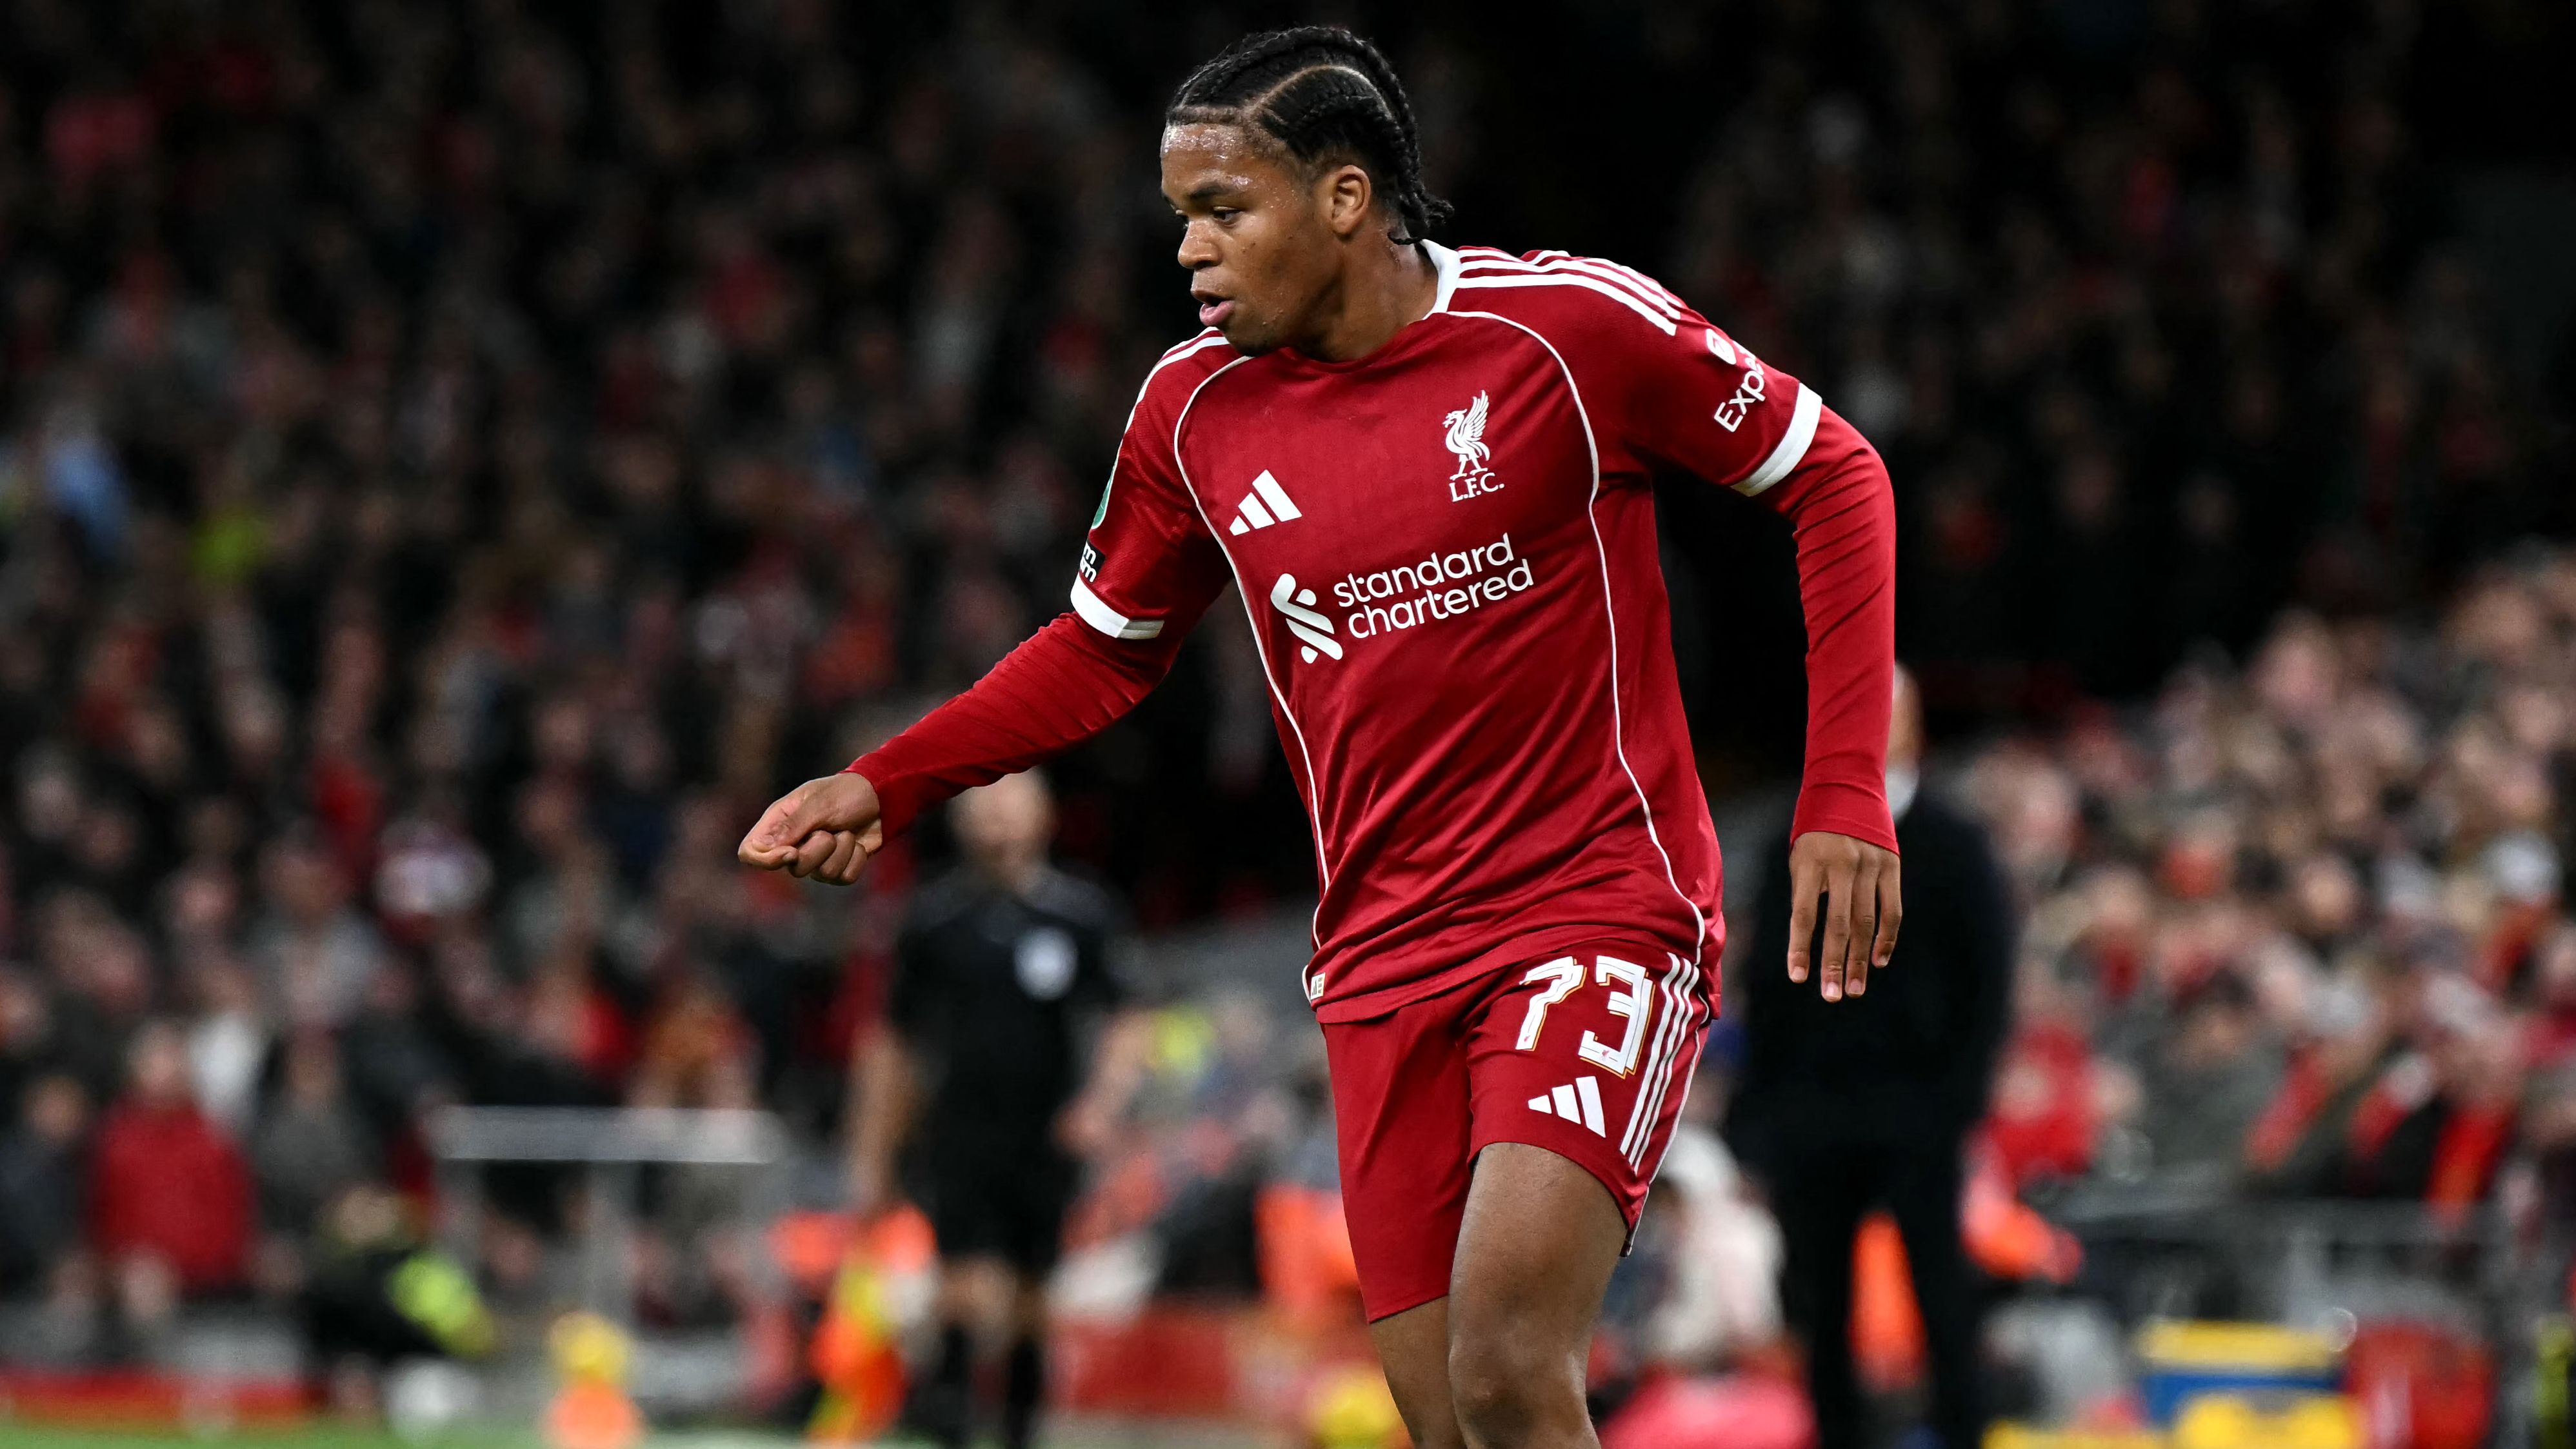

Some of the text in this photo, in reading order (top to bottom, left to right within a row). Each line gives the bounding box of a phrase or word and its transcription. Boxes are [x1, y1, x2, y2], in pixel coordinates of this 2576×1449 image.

[1449, 472, 1505, 503] L.F.C.
[1333, 532, 1514, 607] standard
[1348, 558, 1534, 639] chartered
[1515, 954, 1657, 1080] 73
